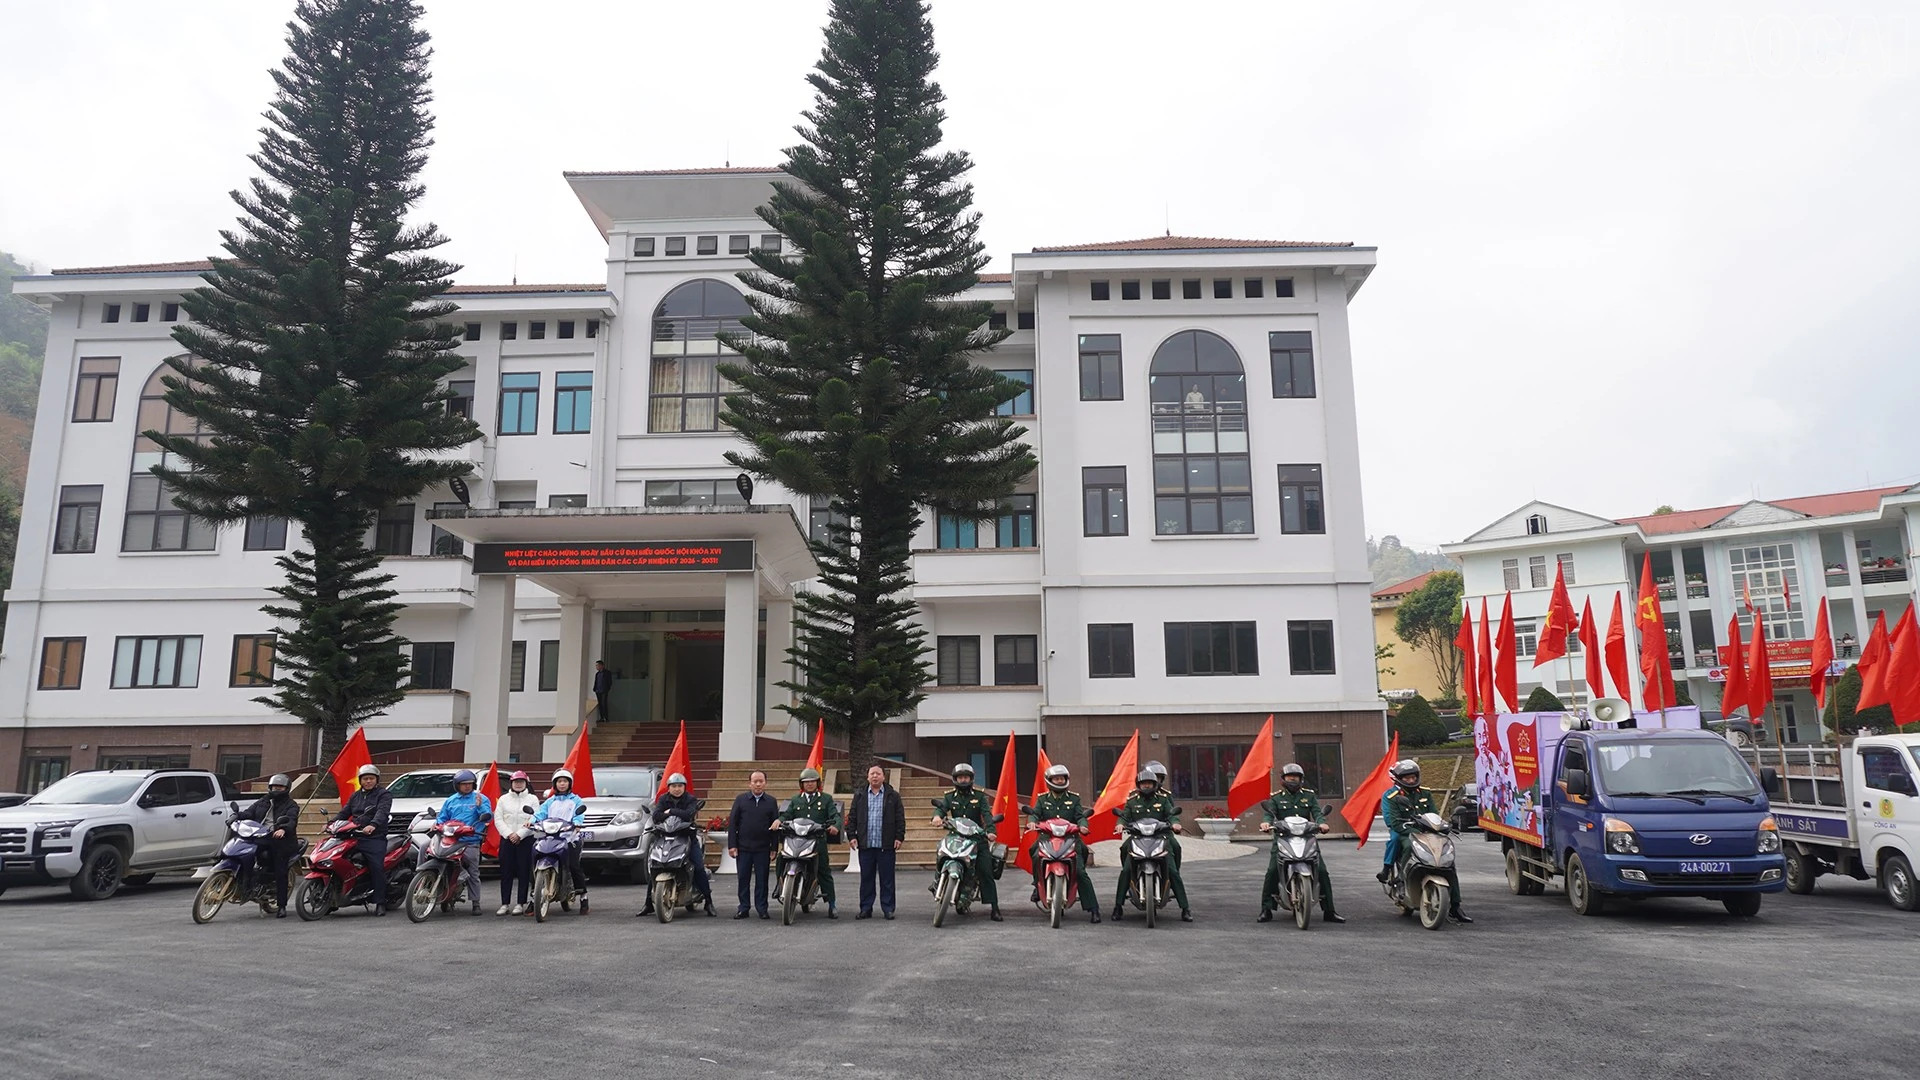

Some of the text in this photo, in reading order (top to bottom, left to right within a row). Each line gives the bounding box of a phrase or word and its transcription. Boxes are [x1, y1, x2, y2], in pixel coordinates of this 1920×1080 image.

[538, 549, 558, 557] CHÀO
[655, 548, 674, 556] QUỐC
[677, 548, 689, 556] HỘI
[690, 546, 708, 555] KHÓA
[581, 558, 600, 566] NHÂN
[601, 558, 616, 566] DÂN
[617, 557, 631, 565] CÁC
[632, 557, 647, 565] CẤP
[680, 557, 695, 565] 2026
[1775, 813, 1817, 832] ẢNH SÁT
[1874, 820, 1897, 830] CÔNG AN
[1681, 862, 1730, 873] 24A-002.71
